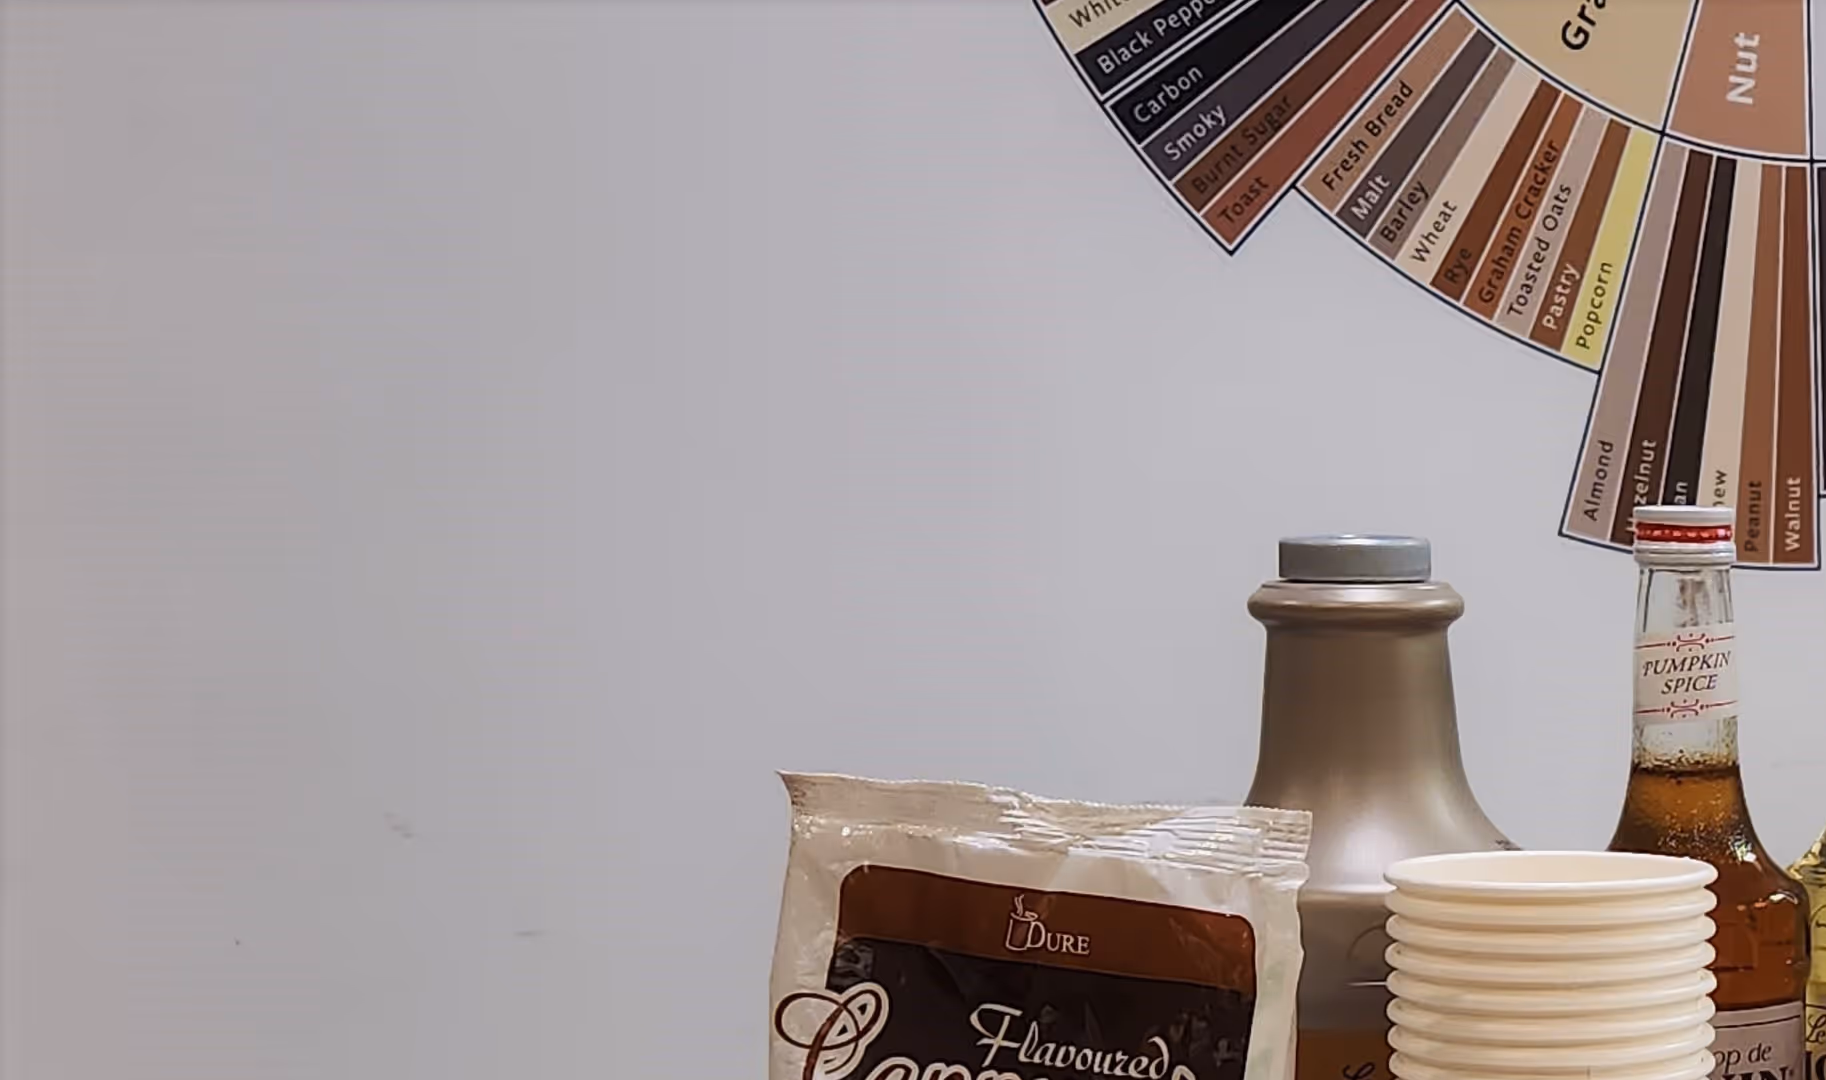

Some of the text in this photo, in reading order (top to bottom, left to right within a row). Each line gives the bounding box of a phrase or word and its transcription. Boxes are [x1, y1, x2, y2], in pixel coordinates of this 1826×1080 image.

[1096, 31, 1154, 74] Black
[1727, 32, 1760, 104] Nut
[1133, 65, 1204, 123] Carbon
[1164, 103, 1226, 161] Smoky
[1191, 94, 1293, 194] Burnt Sugar
[1321, 81, 1415, 191] Fresh Bread
[1217, 175, 1270, 225] Toast
[1351, 172, 1391, 223] Malt
[1380, 180, 1430, 246] Barley
[1477, 140, 1560, 306] Graham Cracker
[1411, 200, 1457, 264] Wheat
[1506, 182, 1573, 318] Toasted Oats
[1443, 245, 1473, 287] Rye
[1541, 263, 1581, 332] Pastry
[1575, 260, 1613, 350] Popcorn
[1584, 440, 1614, 522] Almond
[1625, 439, 1657, 532] zelnut
[1784, 477, 1801, 552] Walnut
[1744, 480, 1762, 553] Peanut
[1642, 651, 1732, 677] PUMPKIN
[1660, 674, 1718, 695] SPICE
[1747, 1043, 1772, 1064] de
